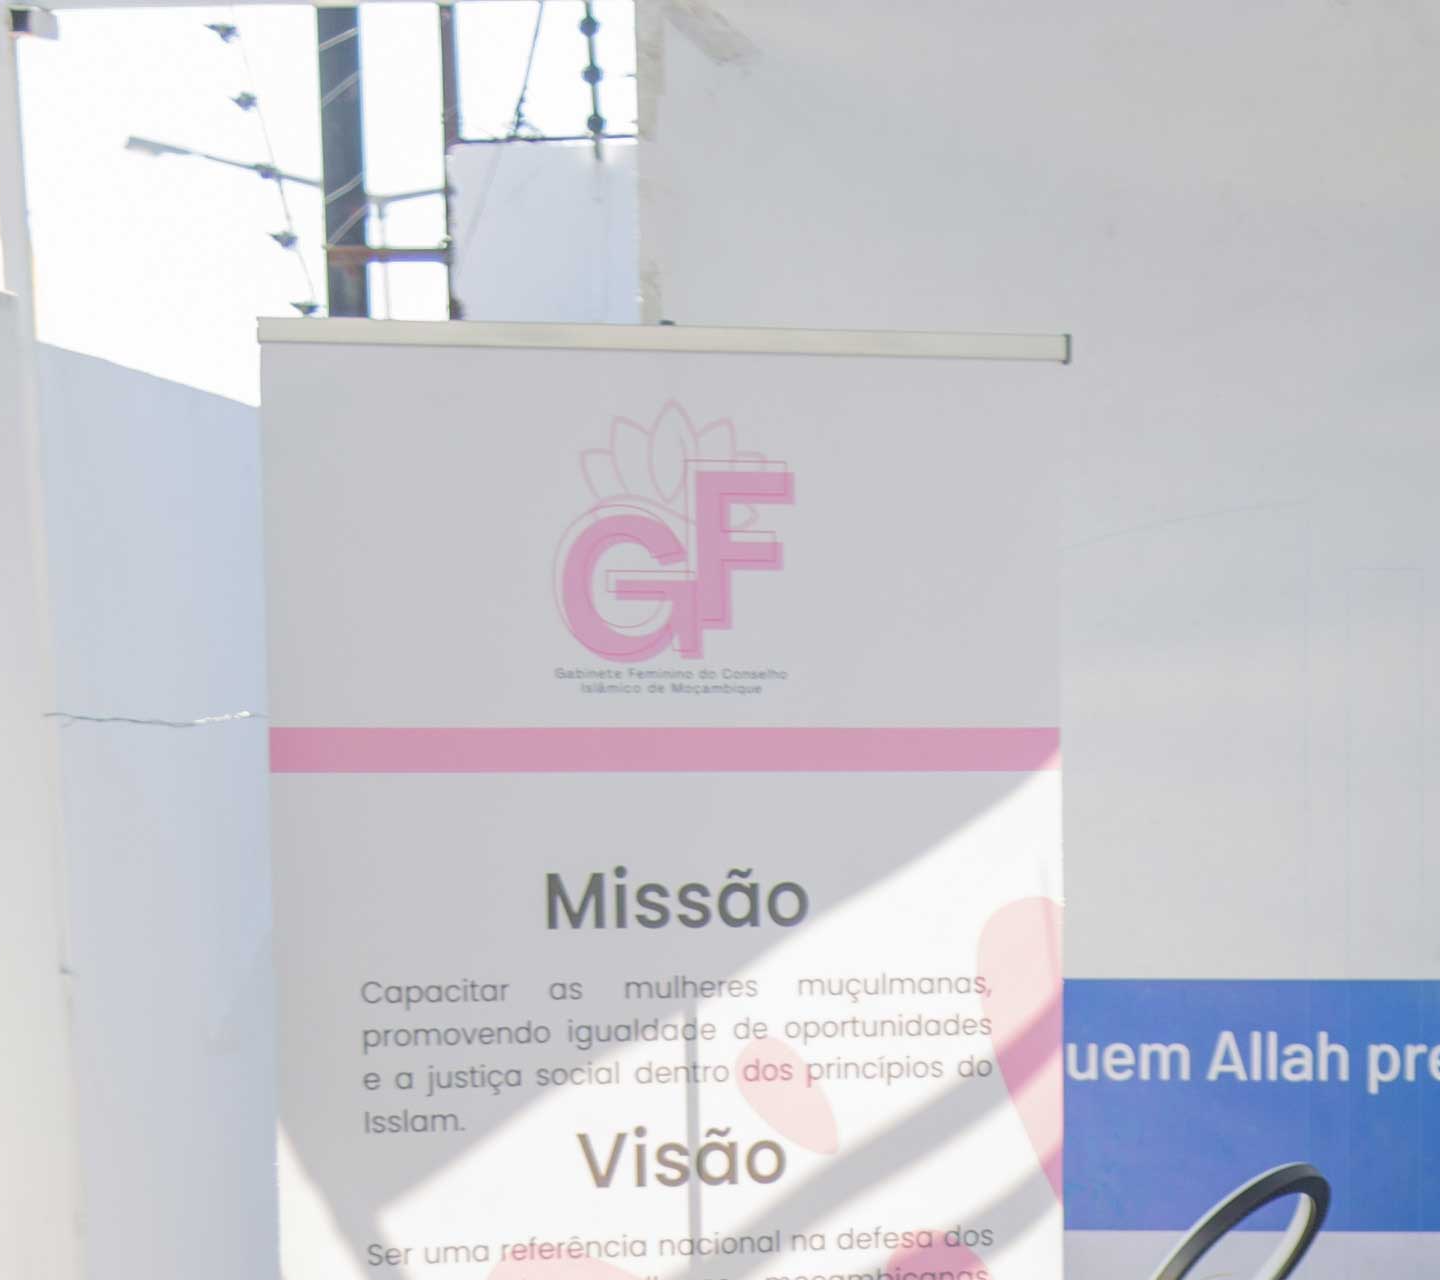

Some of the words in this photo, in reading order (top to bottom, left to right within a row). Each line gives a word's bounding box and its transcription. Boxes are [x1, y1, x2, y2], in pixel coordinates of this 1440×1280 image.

[544, 866, 810, 931] Missão
[360, 978, 510, 1011] Capacitar
[548, 978, 583, 1001] as
[624, 974, 759, 1001] mulheres
[797, 969, 993, 1004] muçulmanas,
[362, 1020, 552, 1055] promovendo
[566, 1016, 723, 1051] igualdade
[732, 1014, 769, 1041] de
[783, 1012, 993, 1047] oportunidades
[1064, 1041, 1191, 1082] uem
[1207, 1030, 1351, 1082] Allah
[363, 1070, 381, 1092] e
[394, 1068, 414, 1091] a
[427, 1062, 523, 1098] justiça
[536, 1059, 621, 1088] social
[634, 1059, 730, 1086] dentro
[742, 1054, 794, 1083] dos
[805, 1053, 943, 1089] princípios
[956, 1052, 994, 1079] do
[363, 1106, 466, 1136] Isslam.
[576, 1125, 788, 1189] Visão
[367, 1242, 413, 1267] Ser
[424, 1243, 491, 1267] uma
[501, 1233, 648, 1263] referência
[658, 1228, 781, 1259] nacional
[790, 1231, 827, 1253] na
[836, 1225, 934, 1252] defesa
[944, 1223, 995, 1249] dos
